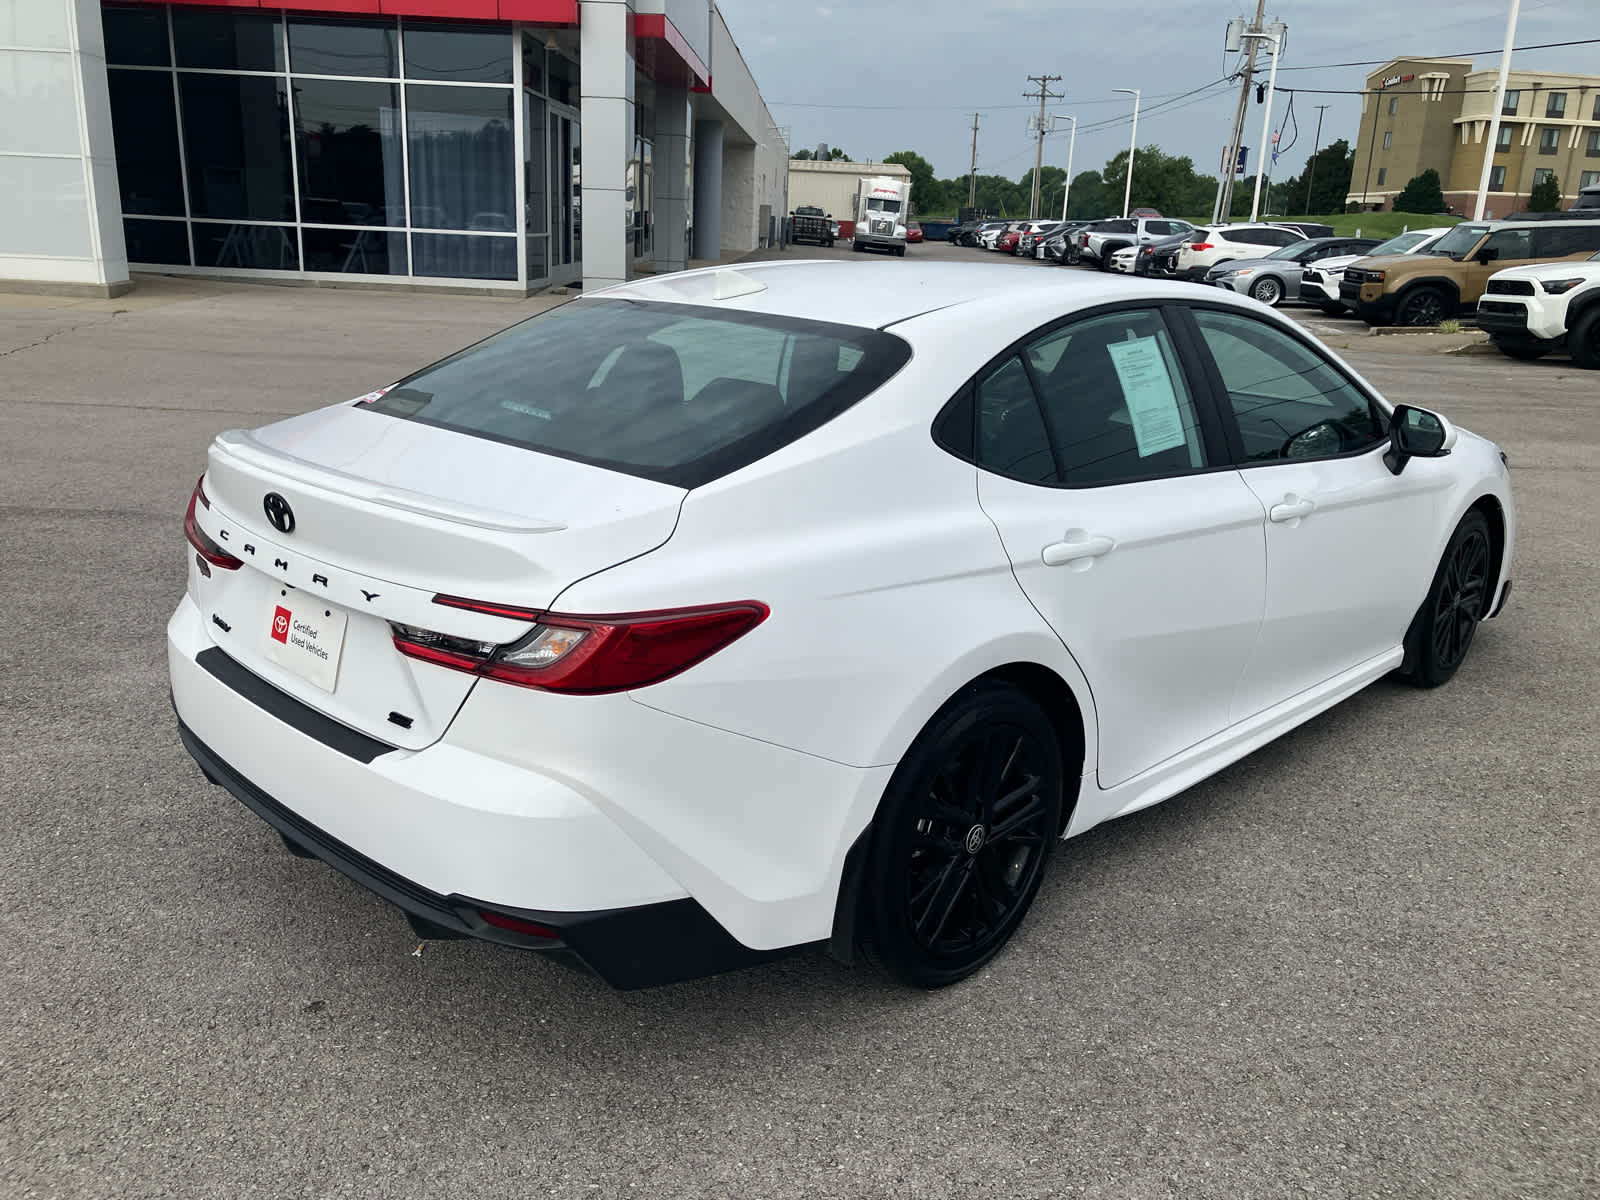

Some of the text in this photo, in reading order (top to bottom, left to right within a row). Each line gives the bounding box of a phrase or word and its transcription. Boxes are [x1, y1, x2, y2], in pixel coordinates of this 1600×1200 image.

[219, 529, 381, 602] CAMRY
[293, 619, 318, 639] Certified
[291, 633, 329, 660] Used Vehicles
